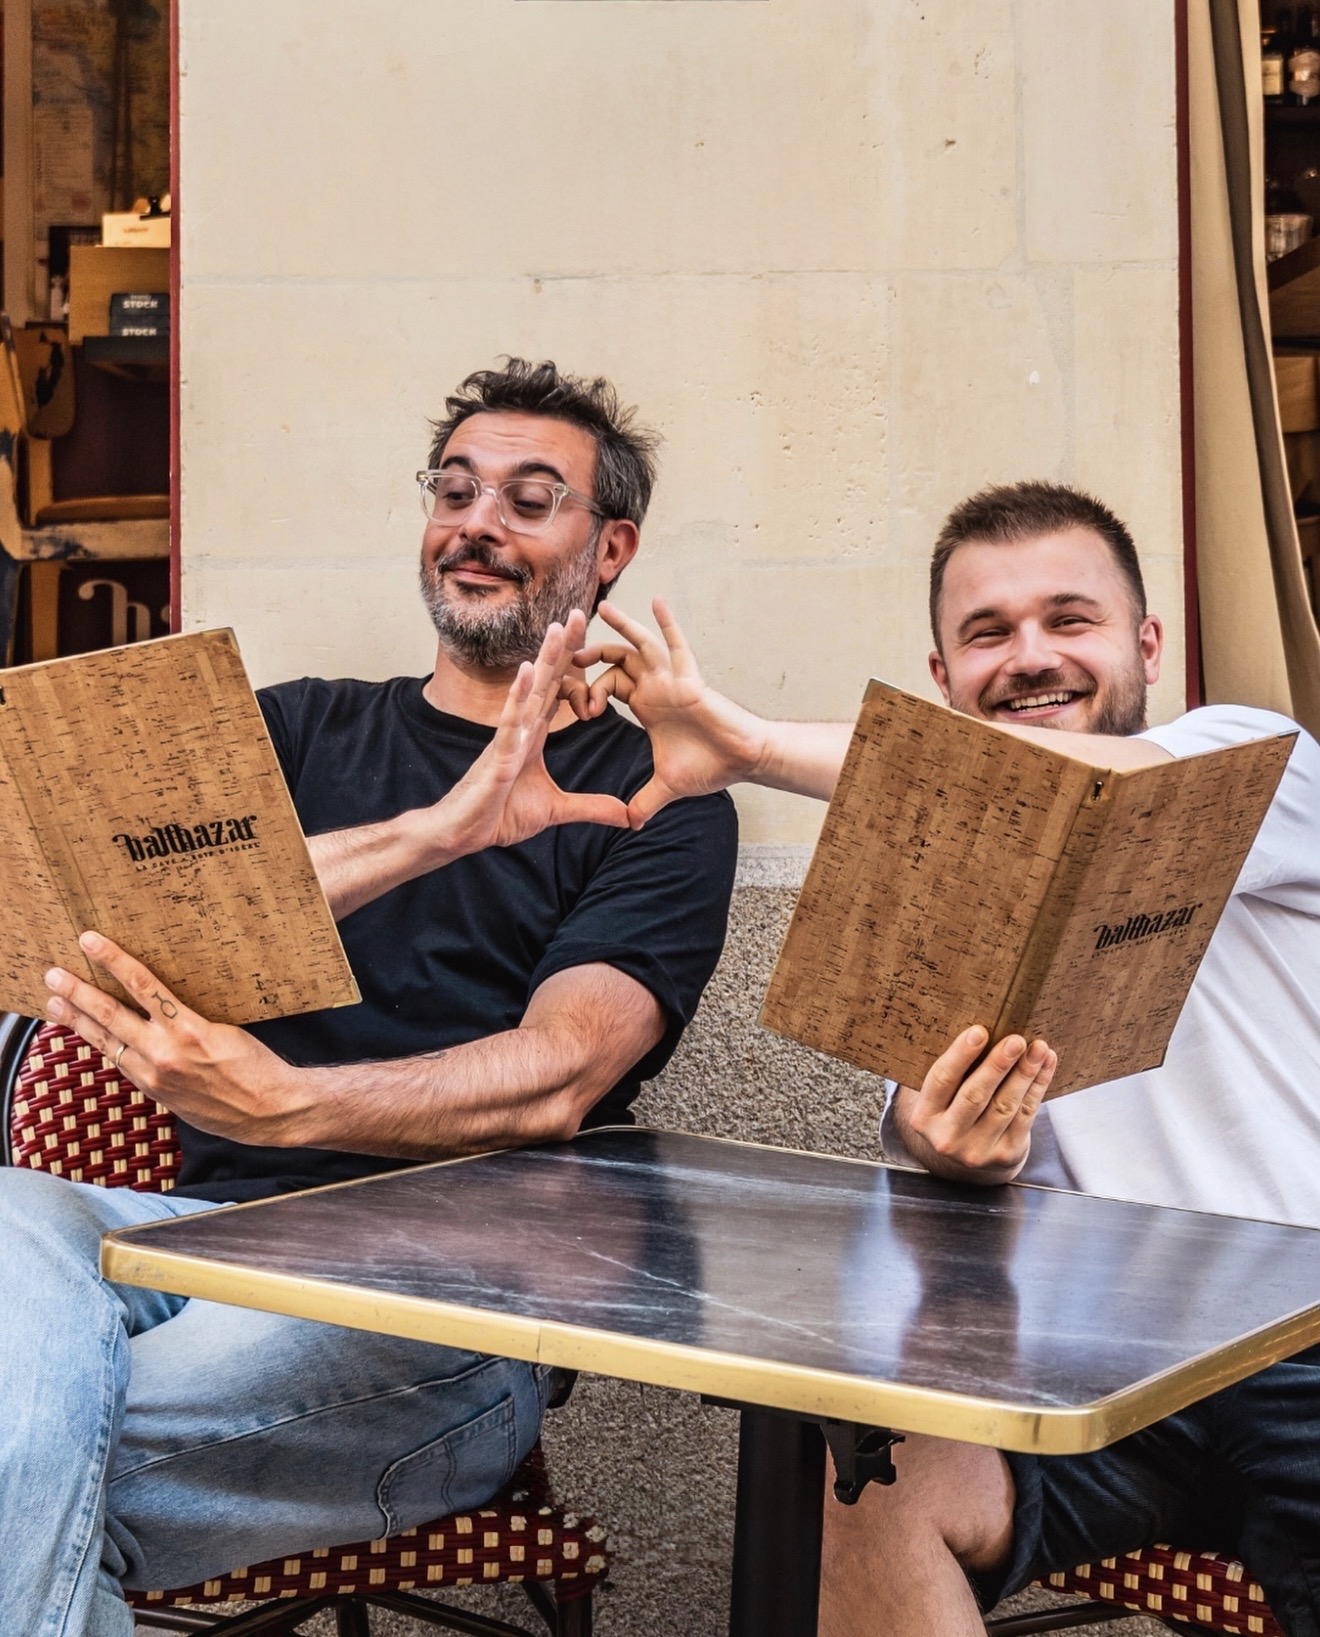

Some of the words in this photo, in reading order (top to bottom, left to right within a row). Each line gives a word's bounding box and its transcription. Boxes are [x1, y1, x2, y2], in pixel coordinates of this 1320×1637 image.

[122, 300, 158, 309] STOCK
[121, 328, 157, 336] STOCK
[112, 815, 257, 862] balthazar
[1093, 902, 1203, 950] balthazar
